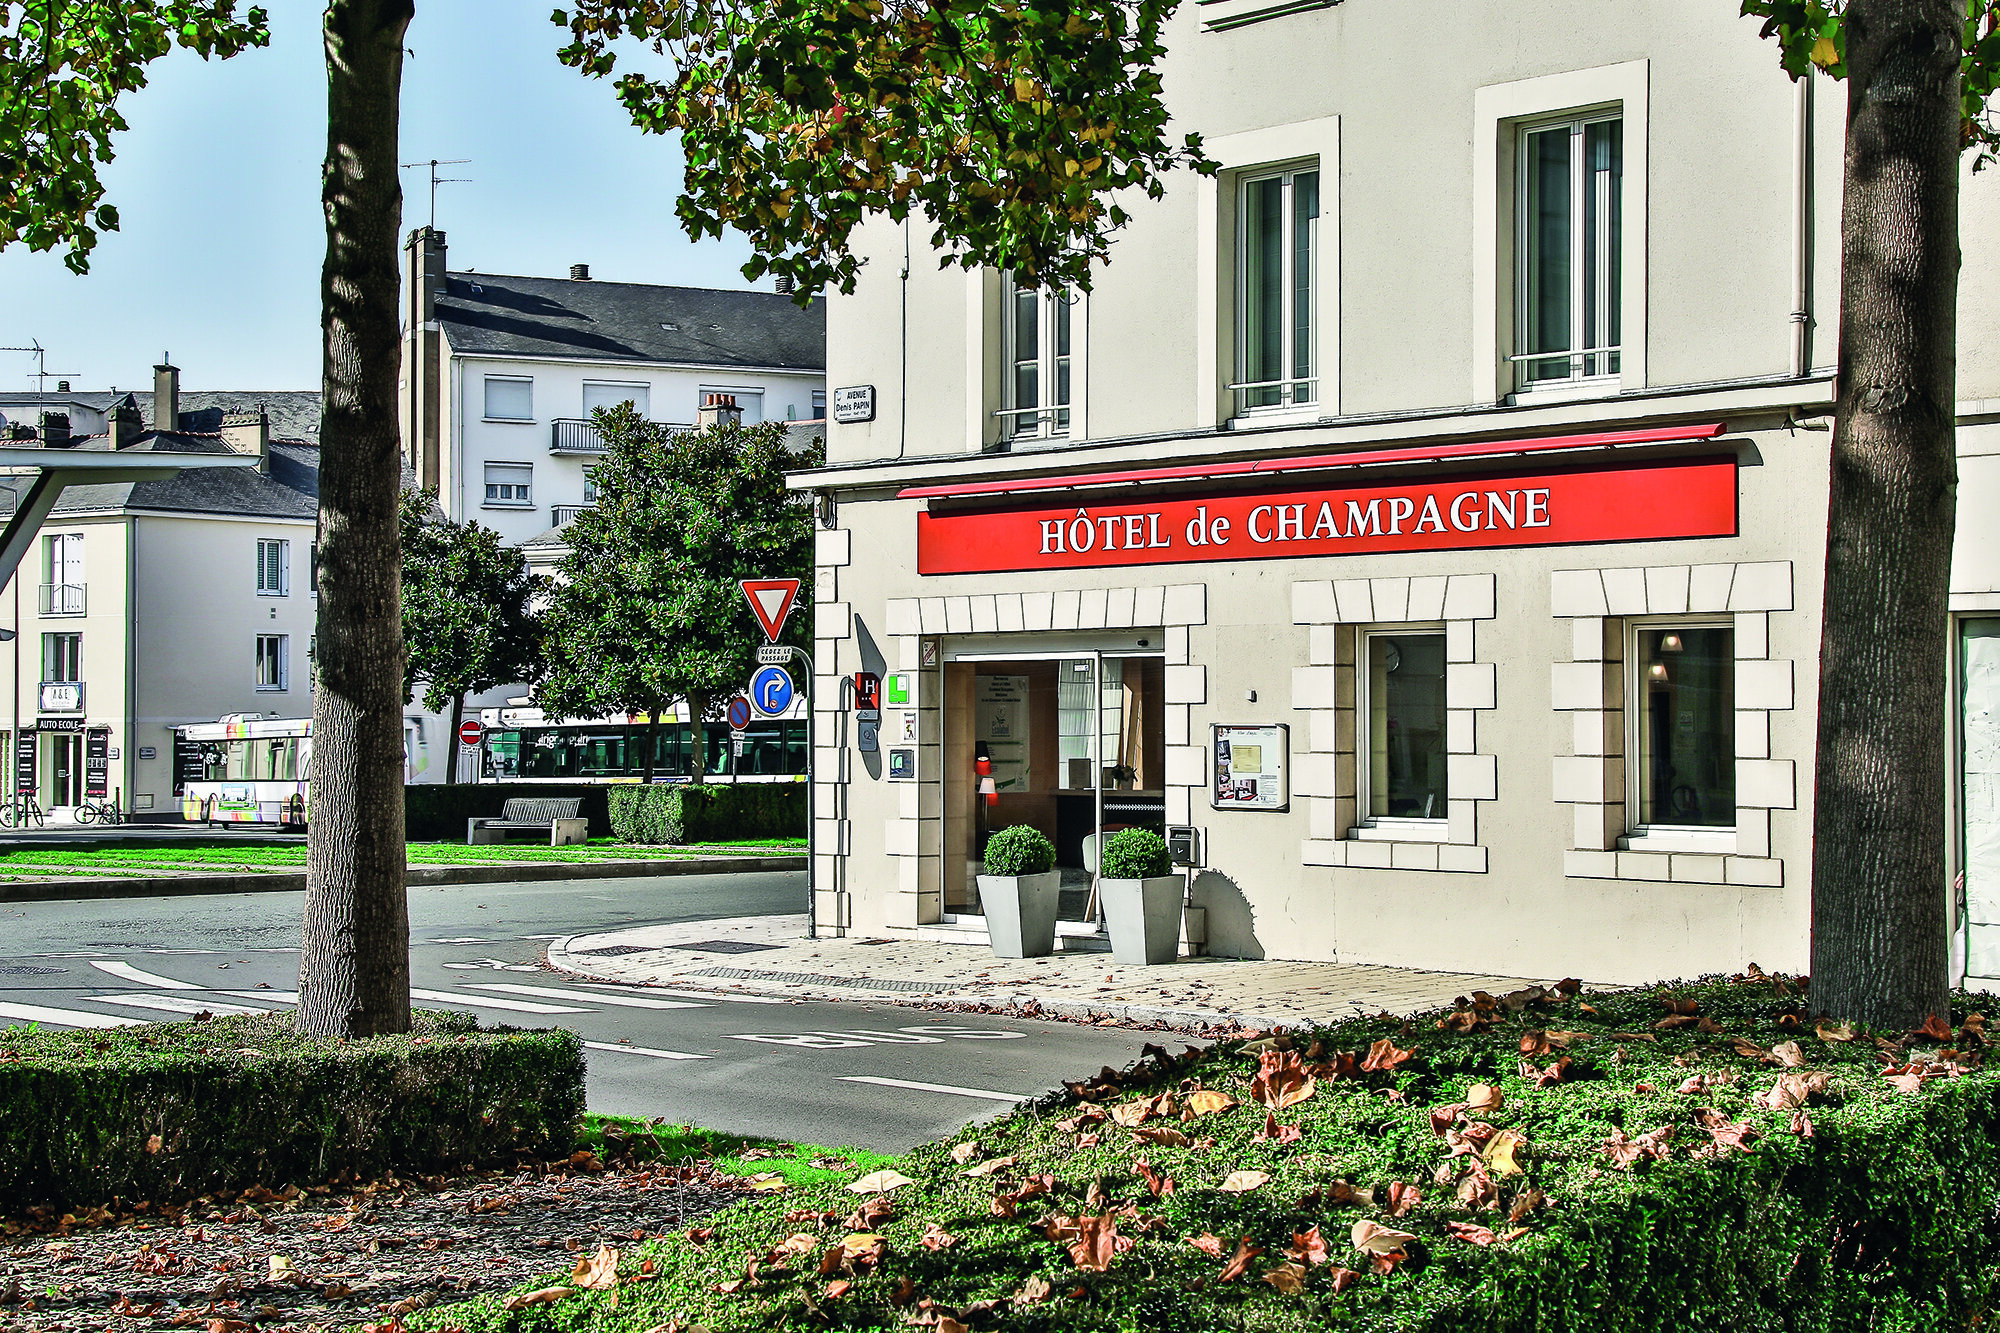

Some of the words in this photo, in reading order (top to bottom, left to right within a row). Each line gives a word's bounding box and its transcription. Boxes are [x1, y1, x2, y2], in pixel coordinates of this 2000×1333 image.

[847, 390, 866, 399] AVENUE
[836, 403, 852, 411] Denis
[853, 401, 869, 410] PAPIN
[1039, 507, 1171, 554] HÔTEL
[1185, 506, 1231, 546] de
[1247, 488, 1551, 543] CHAMPAGNE
[865, 680, 876, 694] H
[40, 720, 58, 729] AUTO
[58, 720, 79, 729] ECOLE
[720, 1026, 1028, 1049] BUS
